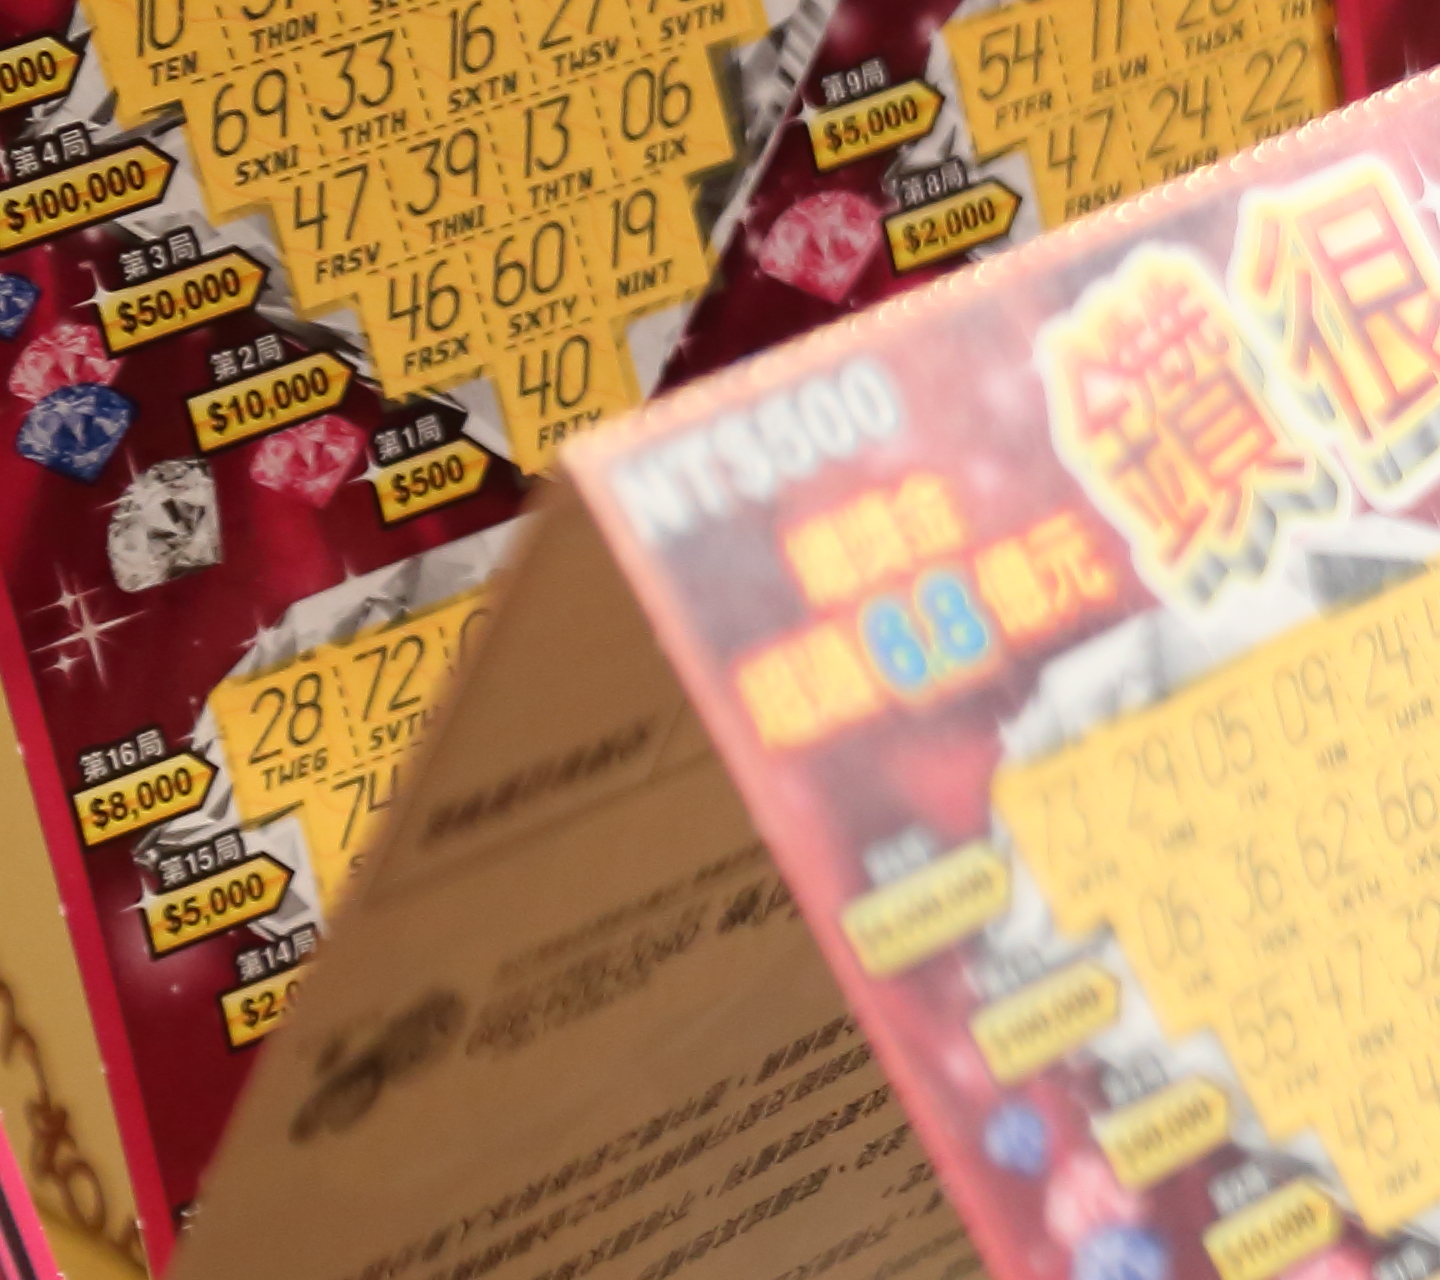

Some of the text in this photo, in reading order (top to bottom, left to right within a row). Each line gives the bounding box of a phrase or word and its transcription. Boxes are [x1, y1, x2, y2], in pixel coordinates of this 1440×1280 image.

[250, 13, 319, 53] THON
[976, 15, 1045, 103] 54
[824, 99, 919, 157] $5,000
[2, 160, 147, 235] $100,000
[119, 233, 198, 282] 第3局
[116, 266, 242, 333] $50,000
[391, 455, 466, 505] $500
[248, 634, 428, 766] 28 72
[80, 730, 164, 783] 第16局
[89, 768, 195, 827] $8,000
